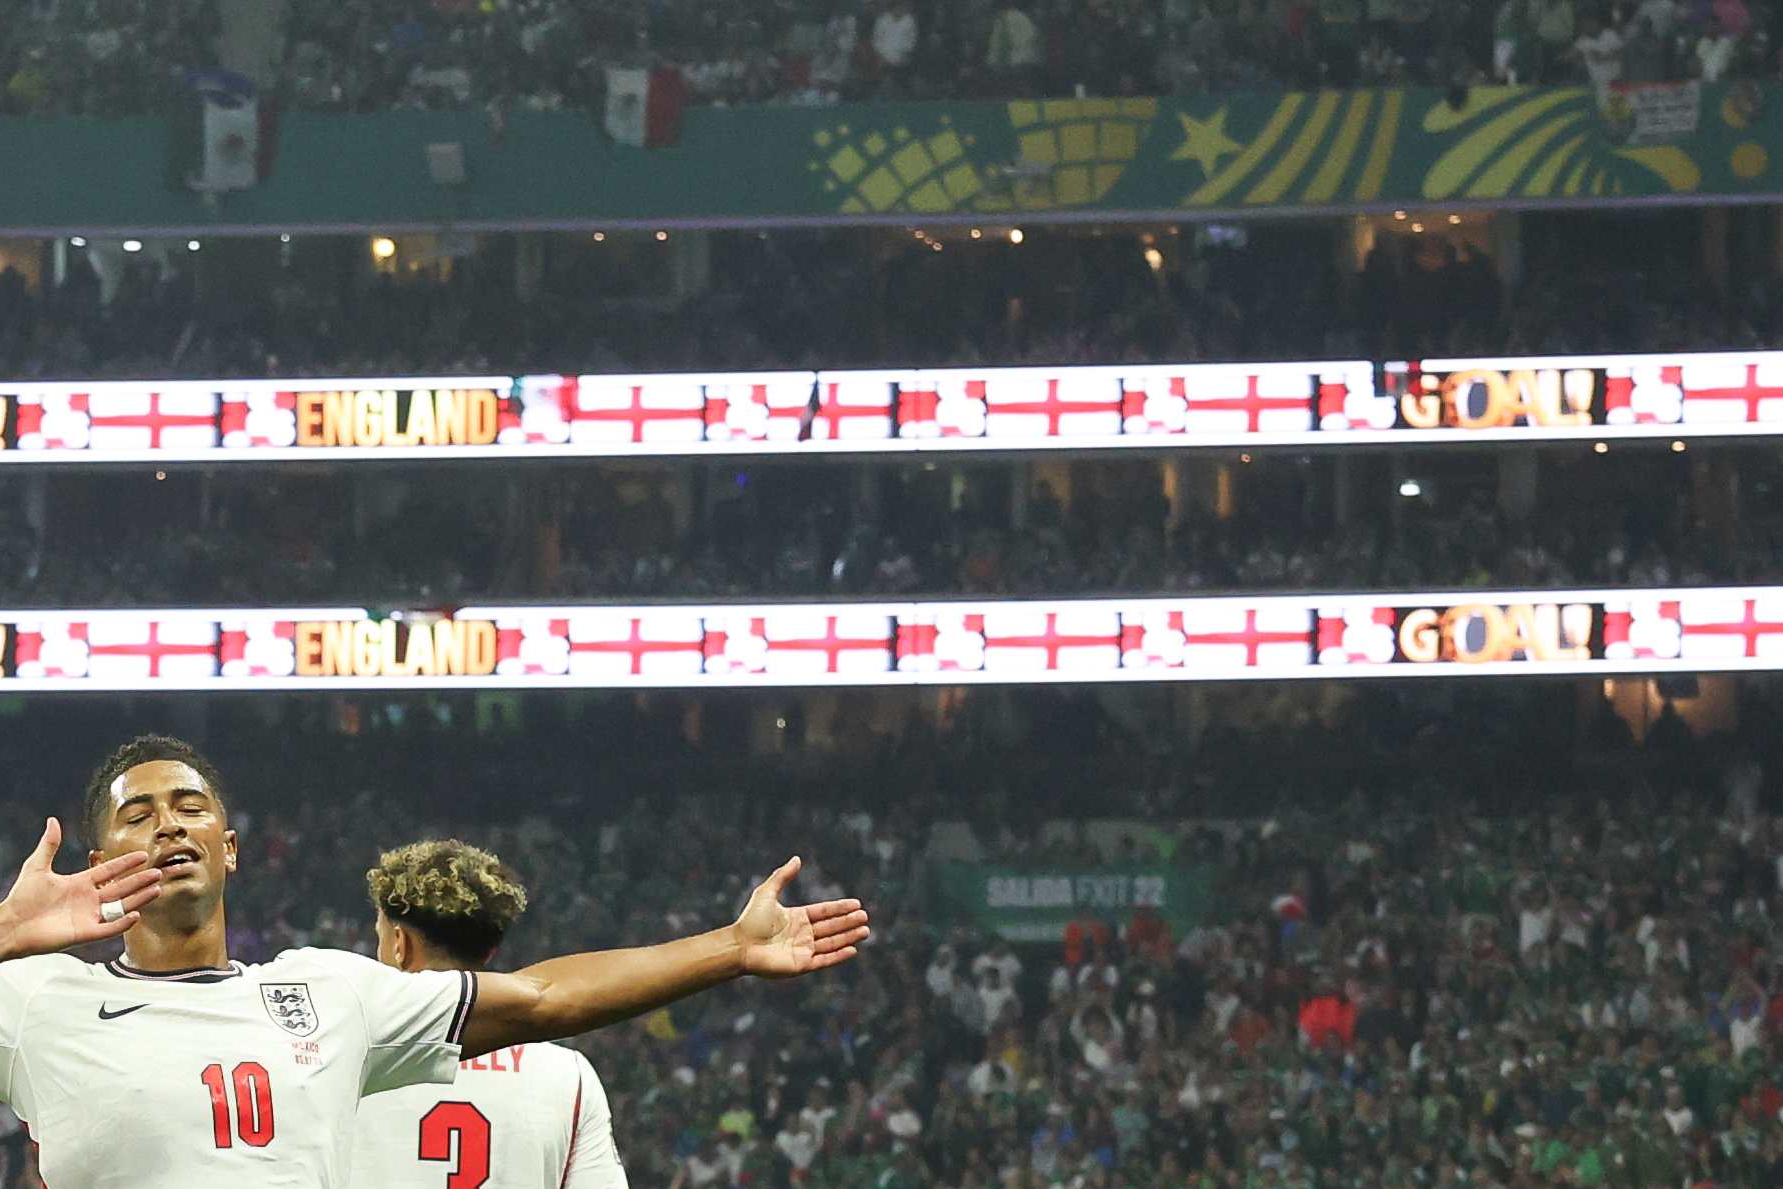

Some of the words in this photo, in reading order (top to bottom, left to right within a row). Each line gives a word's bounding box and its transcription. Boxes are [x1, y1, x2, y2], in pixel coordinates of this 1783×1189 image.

[296, 389, 498, 447] ENGLAND
[1401, 368, 1595, 430] GOAL!
[295, 618, 497, 676] ENGLAND
[1399, 603, 1593, 664] GOAL!
[201, 1061, 275, 1149] 10
